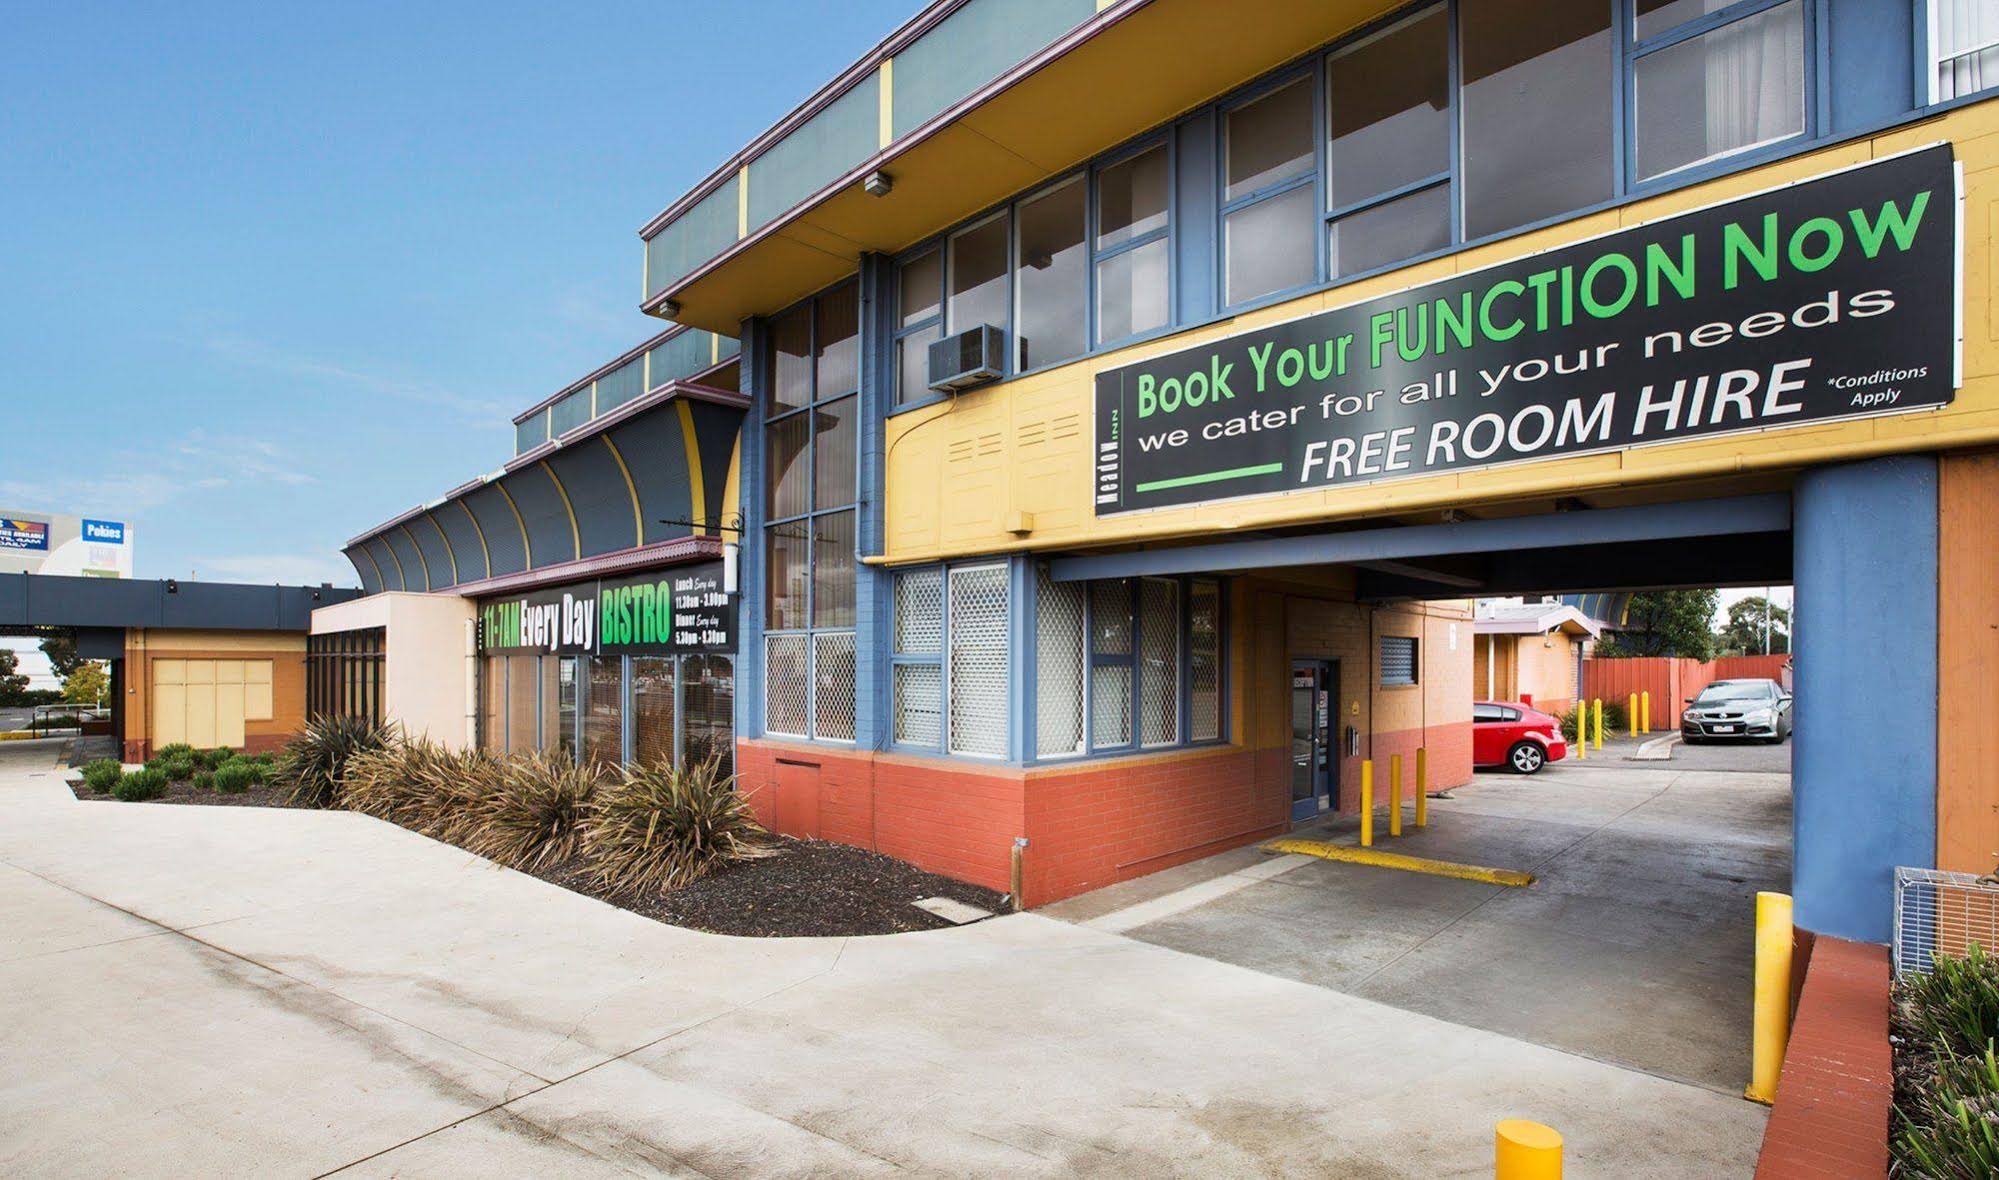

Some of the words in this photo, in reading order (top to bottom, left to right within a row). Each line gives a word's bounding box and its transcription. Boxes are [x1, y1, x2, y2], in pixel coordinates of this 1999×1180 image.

[1137, 355, 1236, 418] Book
[1248, 333, 1354, 392] Your
[1371, 233, 1695, 369] FUNCTION
[1724, 190, 1931, 290] Now
[1138, 428, 1189, 453] we
[1202, 404, 1305, 441] cater
[1320, 389, 1385, 419] for
[1400, 369, 1457, 404] all
[1479, 342, 1620, 397] your
[1644, 289, 1896, 358] needs
[1850, 388, 1901, 407] Apply
[1300, 426, 1416, 483] FREE
[1425, 391, 1616, 466] ROOM
[1632, 357, 1812, 436] HIRE
[1097, 441, 1119, 504] Meadow
[1111, 408, 1119, 440] INN
[87, 524, 121, 539] Pokies
[603, 581, 670, 644] BISTRO
[676, 577, 693, 591] Lunch
[521, 599, 559, 651] Every
[563, 593, 594, 650] Day
[676, 614, 695, 627] Dinner
